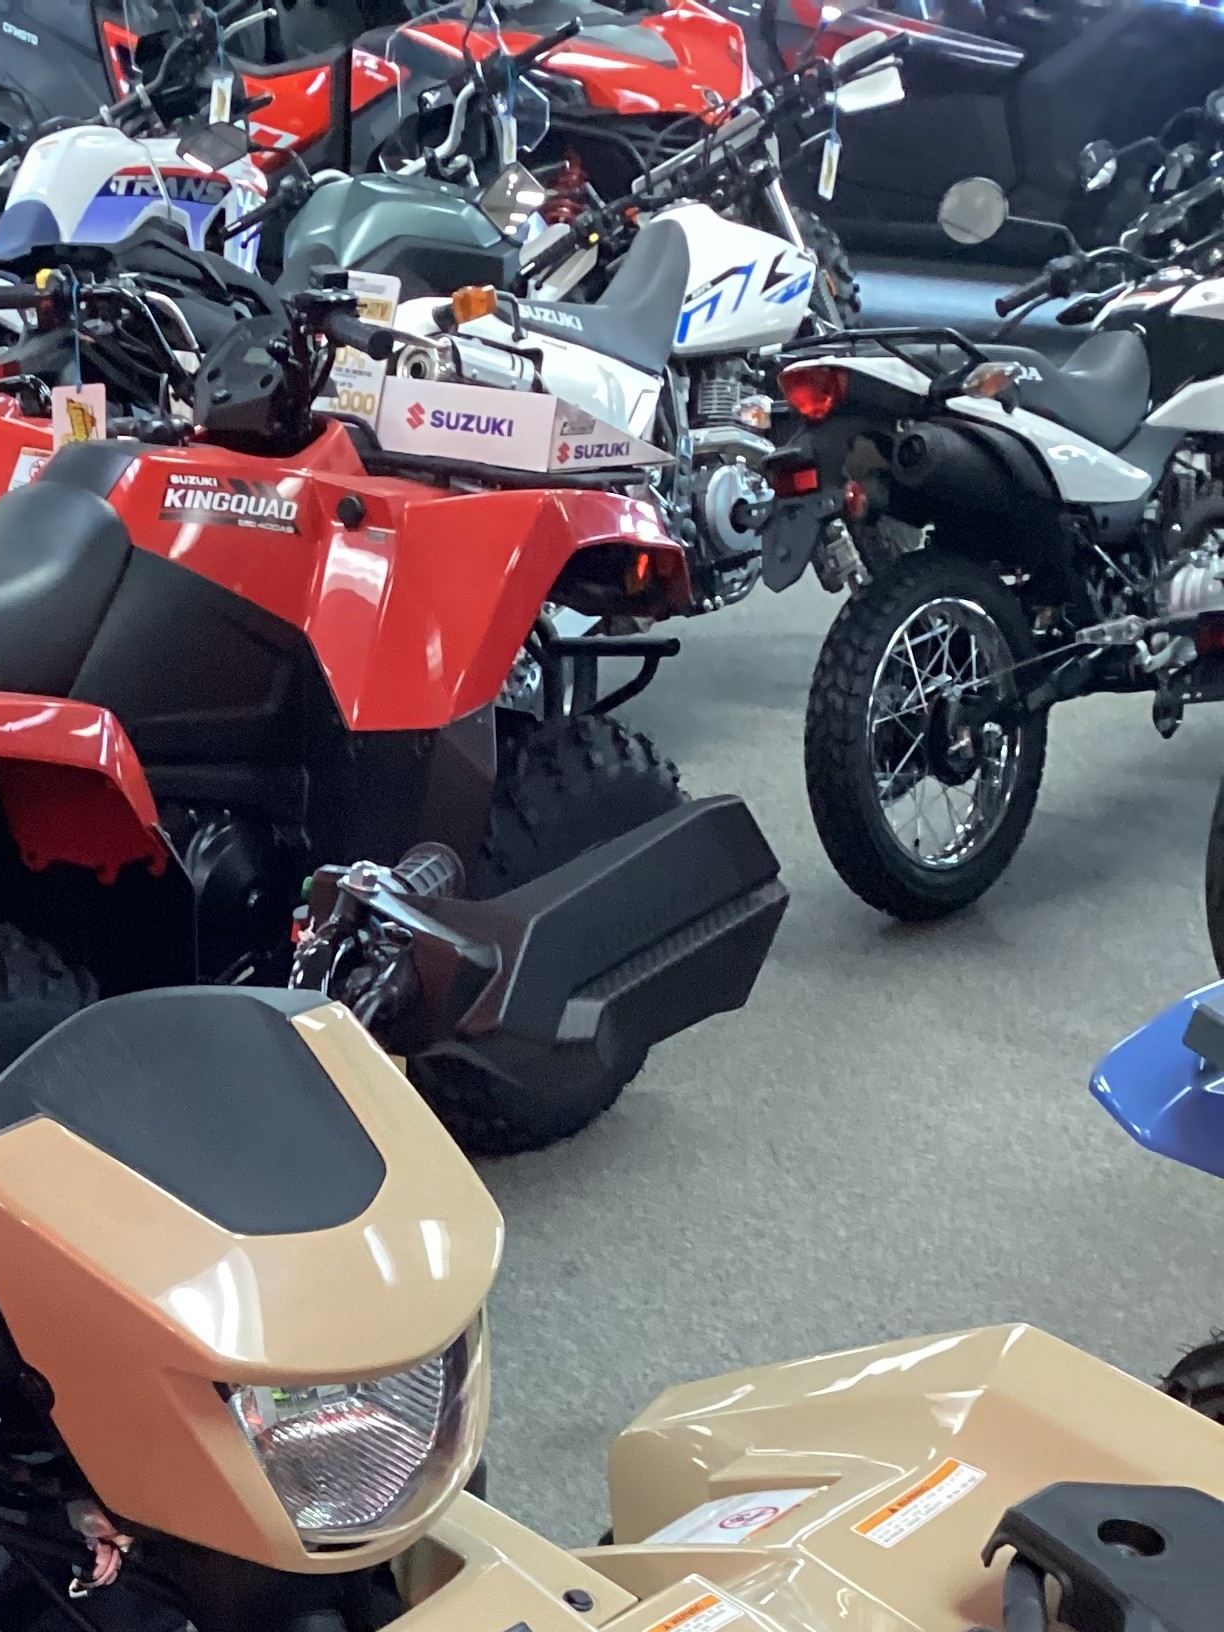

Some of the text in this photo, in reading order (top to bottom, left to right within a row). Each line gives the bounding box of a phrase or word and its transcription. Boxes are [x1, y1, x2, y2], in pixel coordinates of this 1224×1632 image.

[109, 174, 227, 205] TRANS
[518, 303, 584, 331] SUZUKI
[429, 409, 514, 438] SUZUKI
[573, 441, 631, 460] SUZUKI
[169, 474, 218, 487] SUZUKI
[164, 488, 298, 521] KINGQUAD
